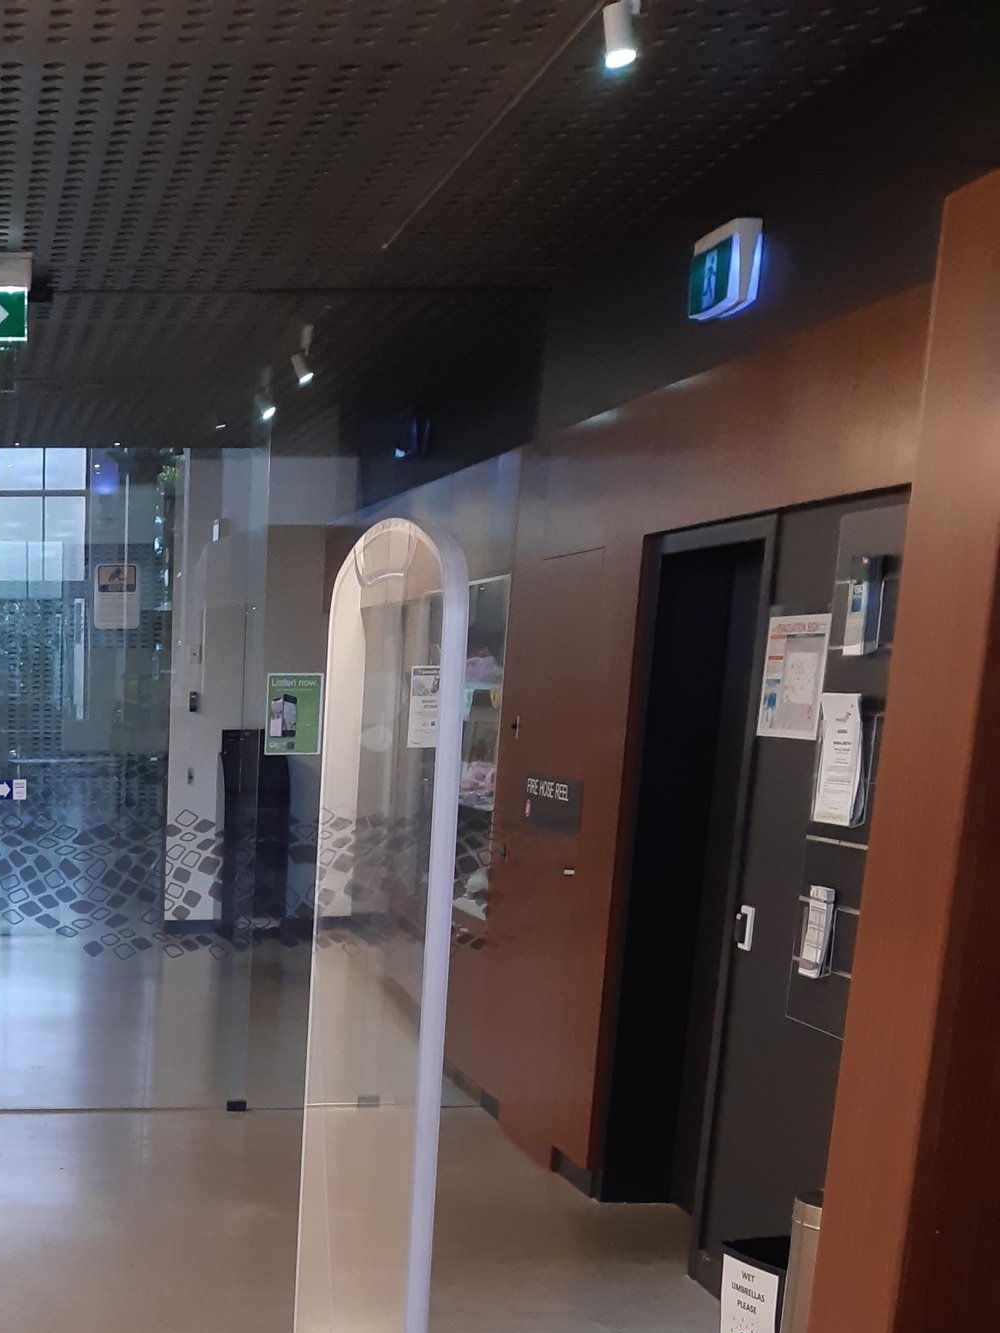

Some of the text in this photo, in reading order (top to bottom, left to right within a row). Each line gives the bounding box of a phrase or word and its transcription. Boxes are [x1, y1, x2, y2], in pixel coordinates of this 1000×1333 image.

[271, 678, 297, 687] Listen
[527, 778, 569, 801] FIRE HOSE REEL
[741, 1270, 755, 1283] WET
[731, 1281, 765, 1303] UMBRELLAS
[736, 1299, 757, 1315] PLEASE
